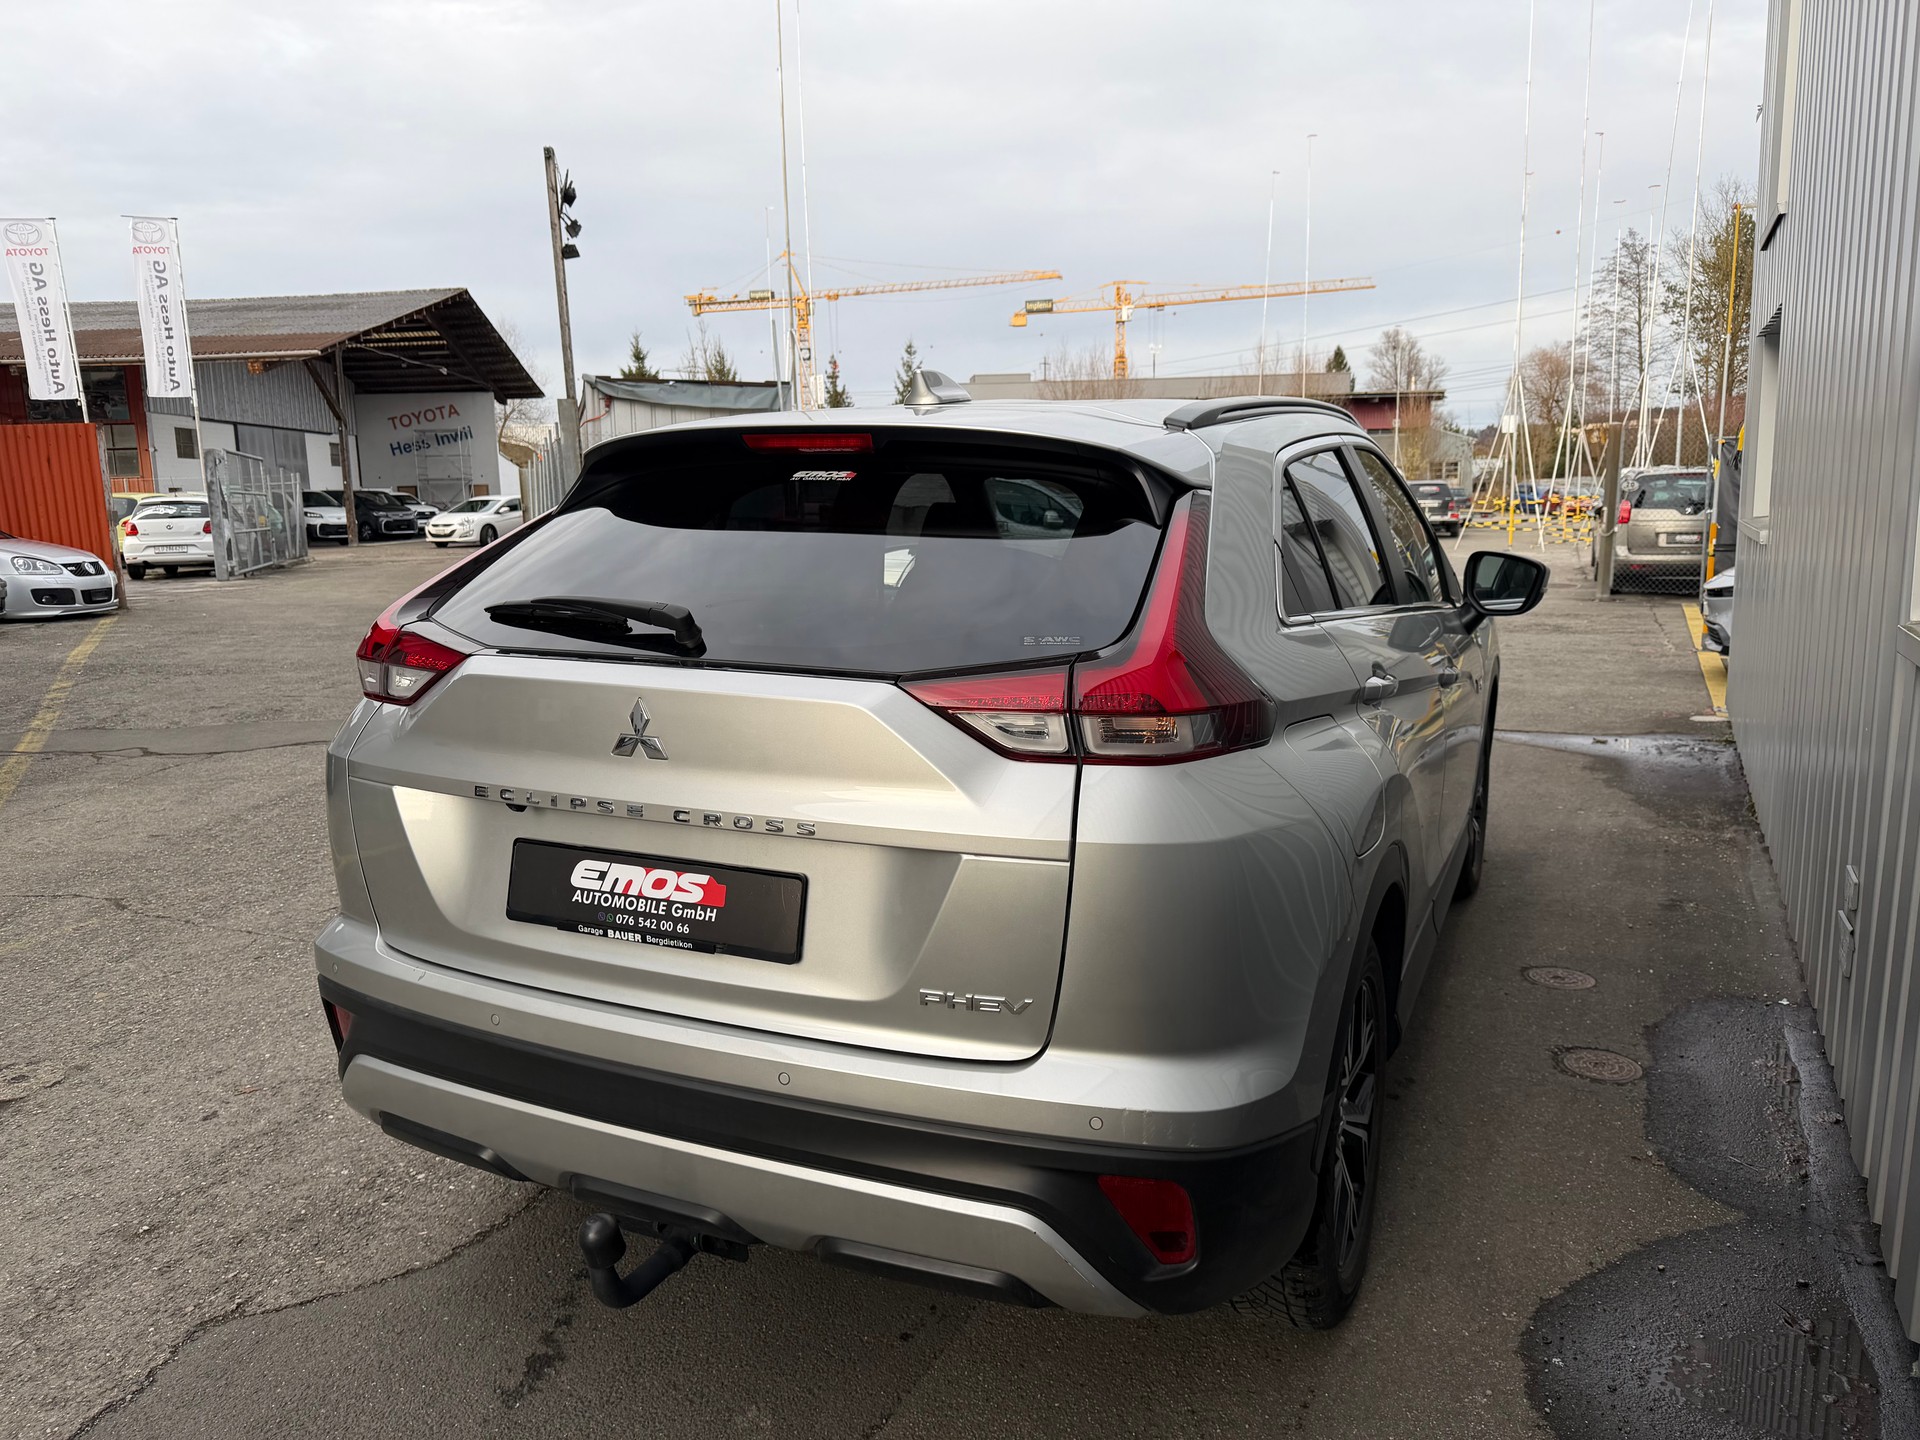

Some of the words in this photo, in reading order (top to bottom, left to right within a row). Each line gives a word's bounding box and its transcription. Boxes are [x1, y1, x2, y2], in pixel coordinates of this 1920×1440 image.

[388, 404, 460, 430] TOYOTA
[390, 440, 431, 456] Hess
[435, 425, 473, 446] Inwil
[474, 785, 644, 818] ECLIPSE
[673, 809, 816, 836] CROSS
[570, 859, 711, 904] EMOS
[572, 889, 667, 915] AUTOMOBILE
[671, 903, 717, 922] GmbH
[578, 924, 603, 936] Garage
[607, 929, 642, 943] BAUER
[646, 935, 693, 949] Bergdietikon
[615, 914, 635, 926] 076
[638, 917, 657, 929] 542
[660, 920, 673, 932] 00
[676, 922, 690, 934] 66
[920, 988, 1033, 1015] PHEV
